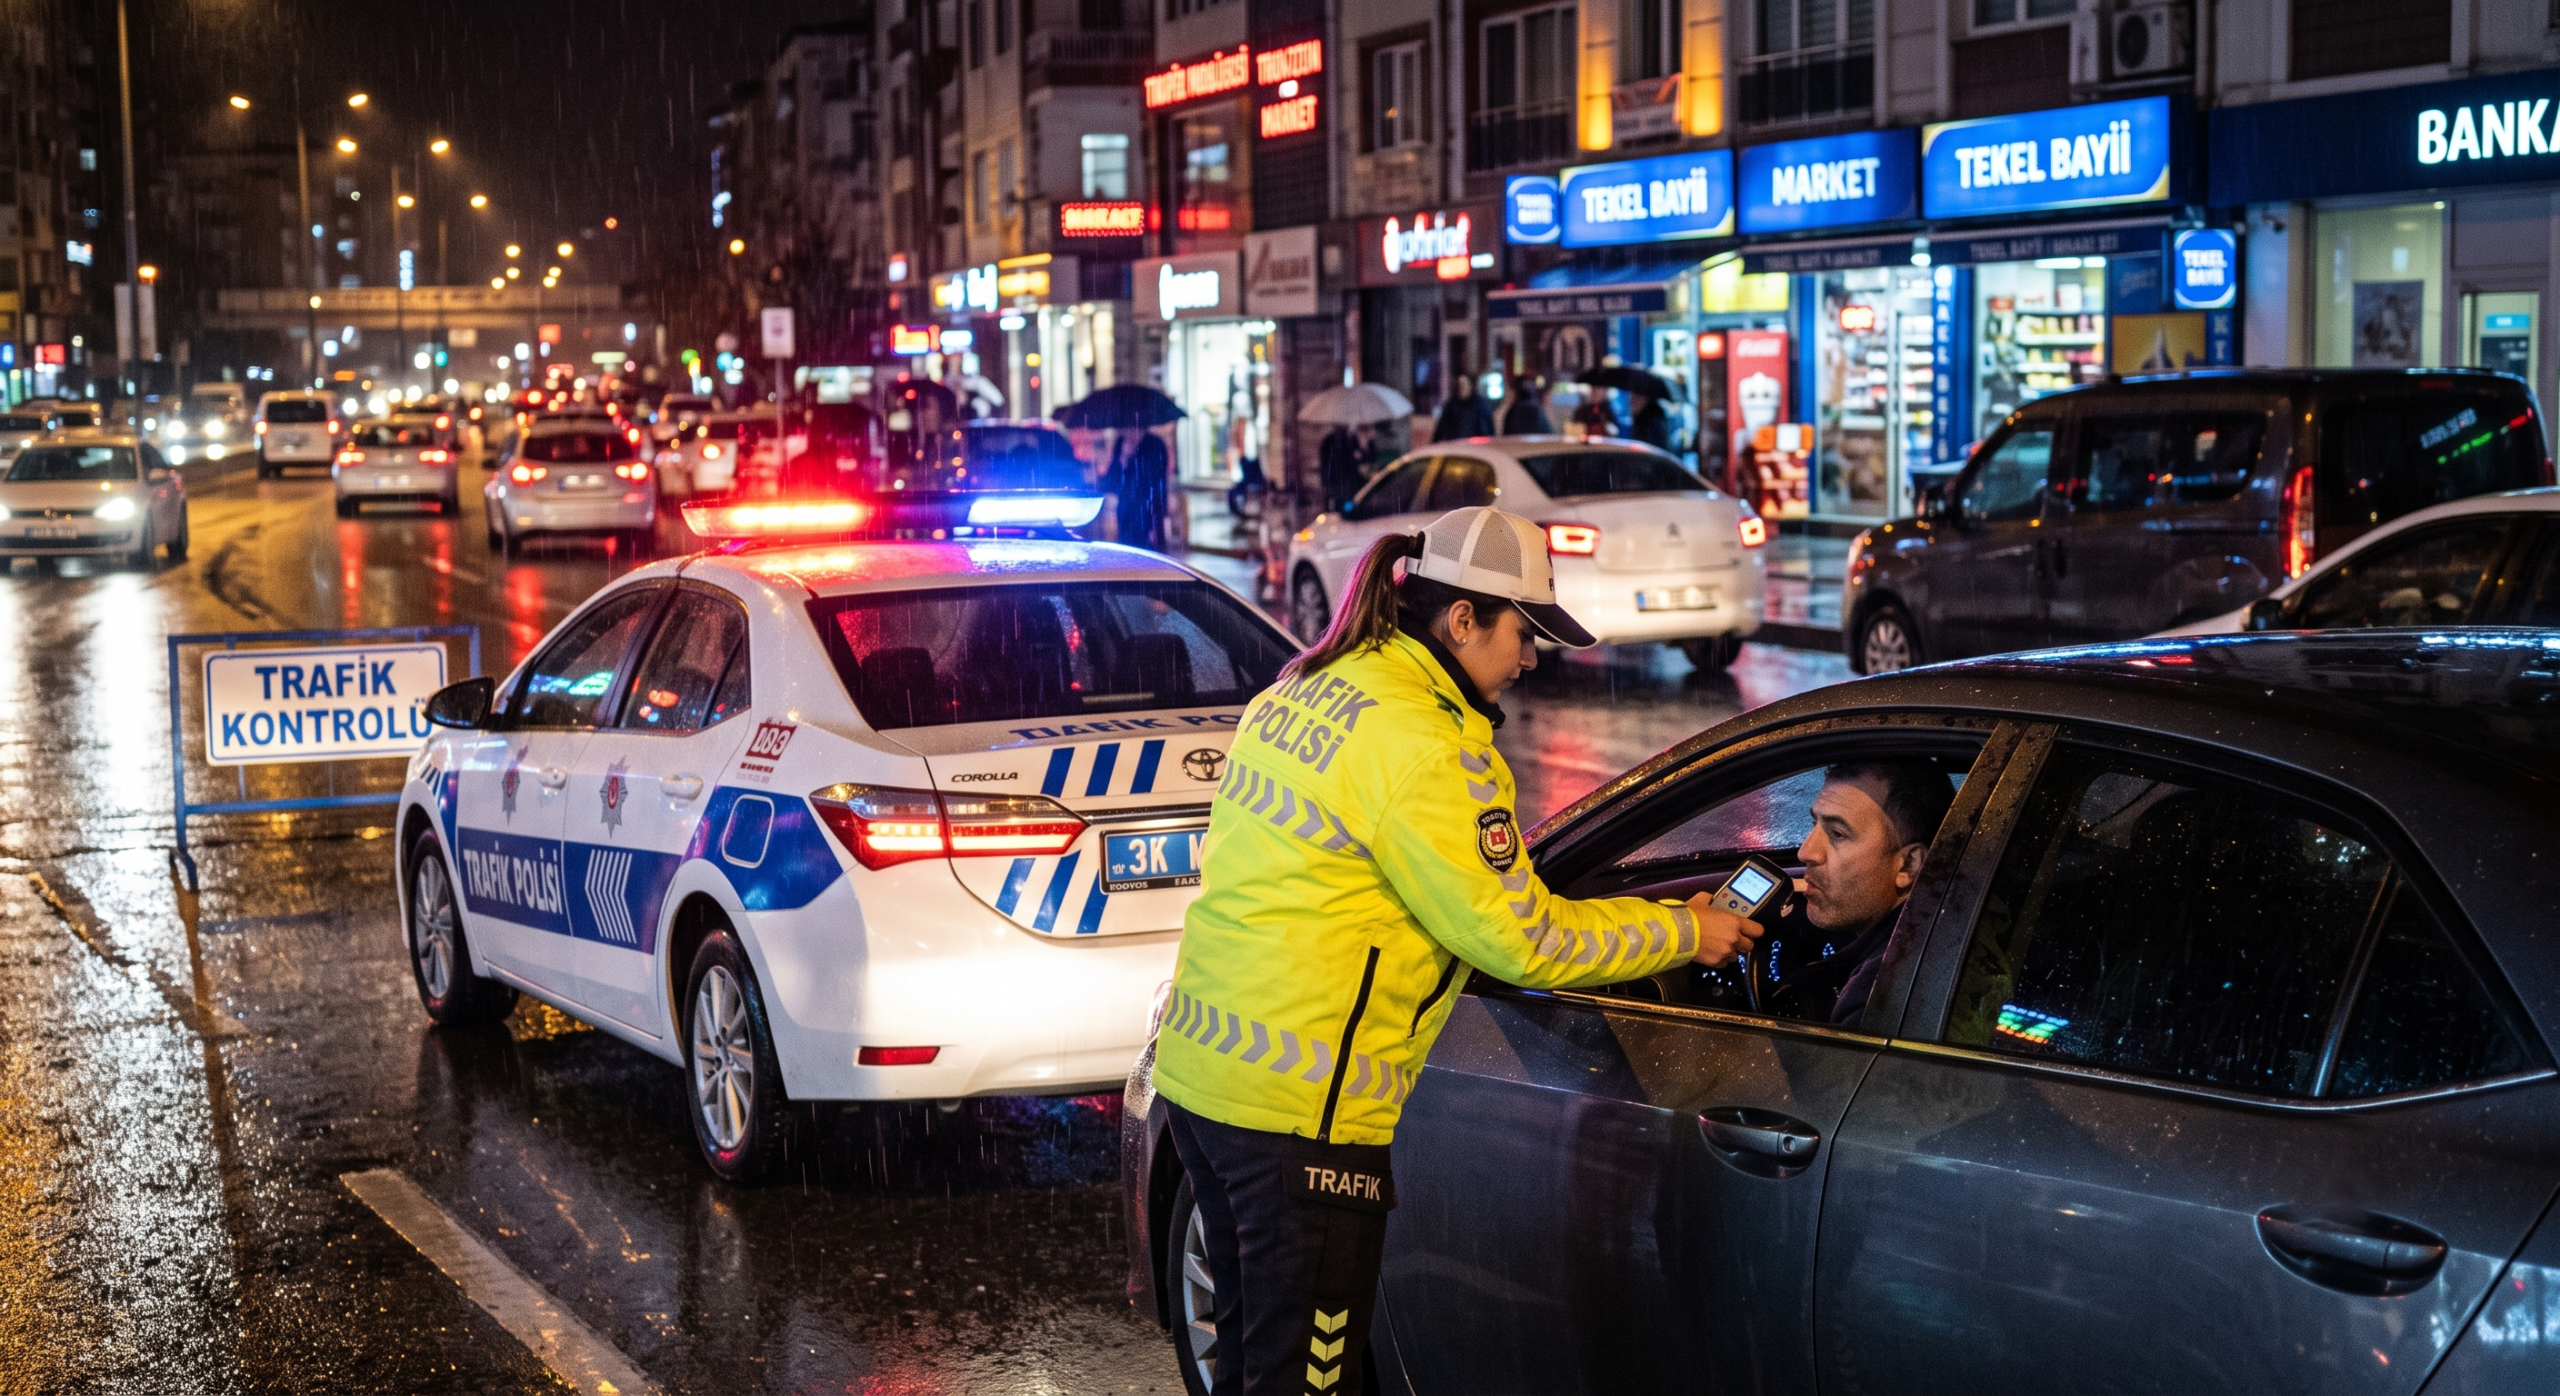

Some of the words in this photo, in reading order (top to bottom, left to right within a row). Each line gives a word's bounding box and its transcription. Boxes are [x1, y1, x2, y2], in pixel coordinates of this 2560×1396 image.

[1955, 139, 2046, 189] TEKEL
[2050, 119, 2131, 181] BAYİİ
[1581, 182, 1648, 223] TEKEL
[1649, 166, 1708, 218] BAYİİ
[1772, 157, 1880, 206] MARKET
[254, 655, 397, 700] TRAFİK
[221, 697, 433, 748] KONTROLÜ
[1245, 699, 1346, 775] POLİSİ
[951, 771, 1018, 784] COROLLA
[463, 841, 515, 905] TRAFİK
[513, 847, 563, 915] POLİSİ
[1128, 836, 1168, 876] 3K
[1304, 1166, 1381, 1201] TRAFIK
